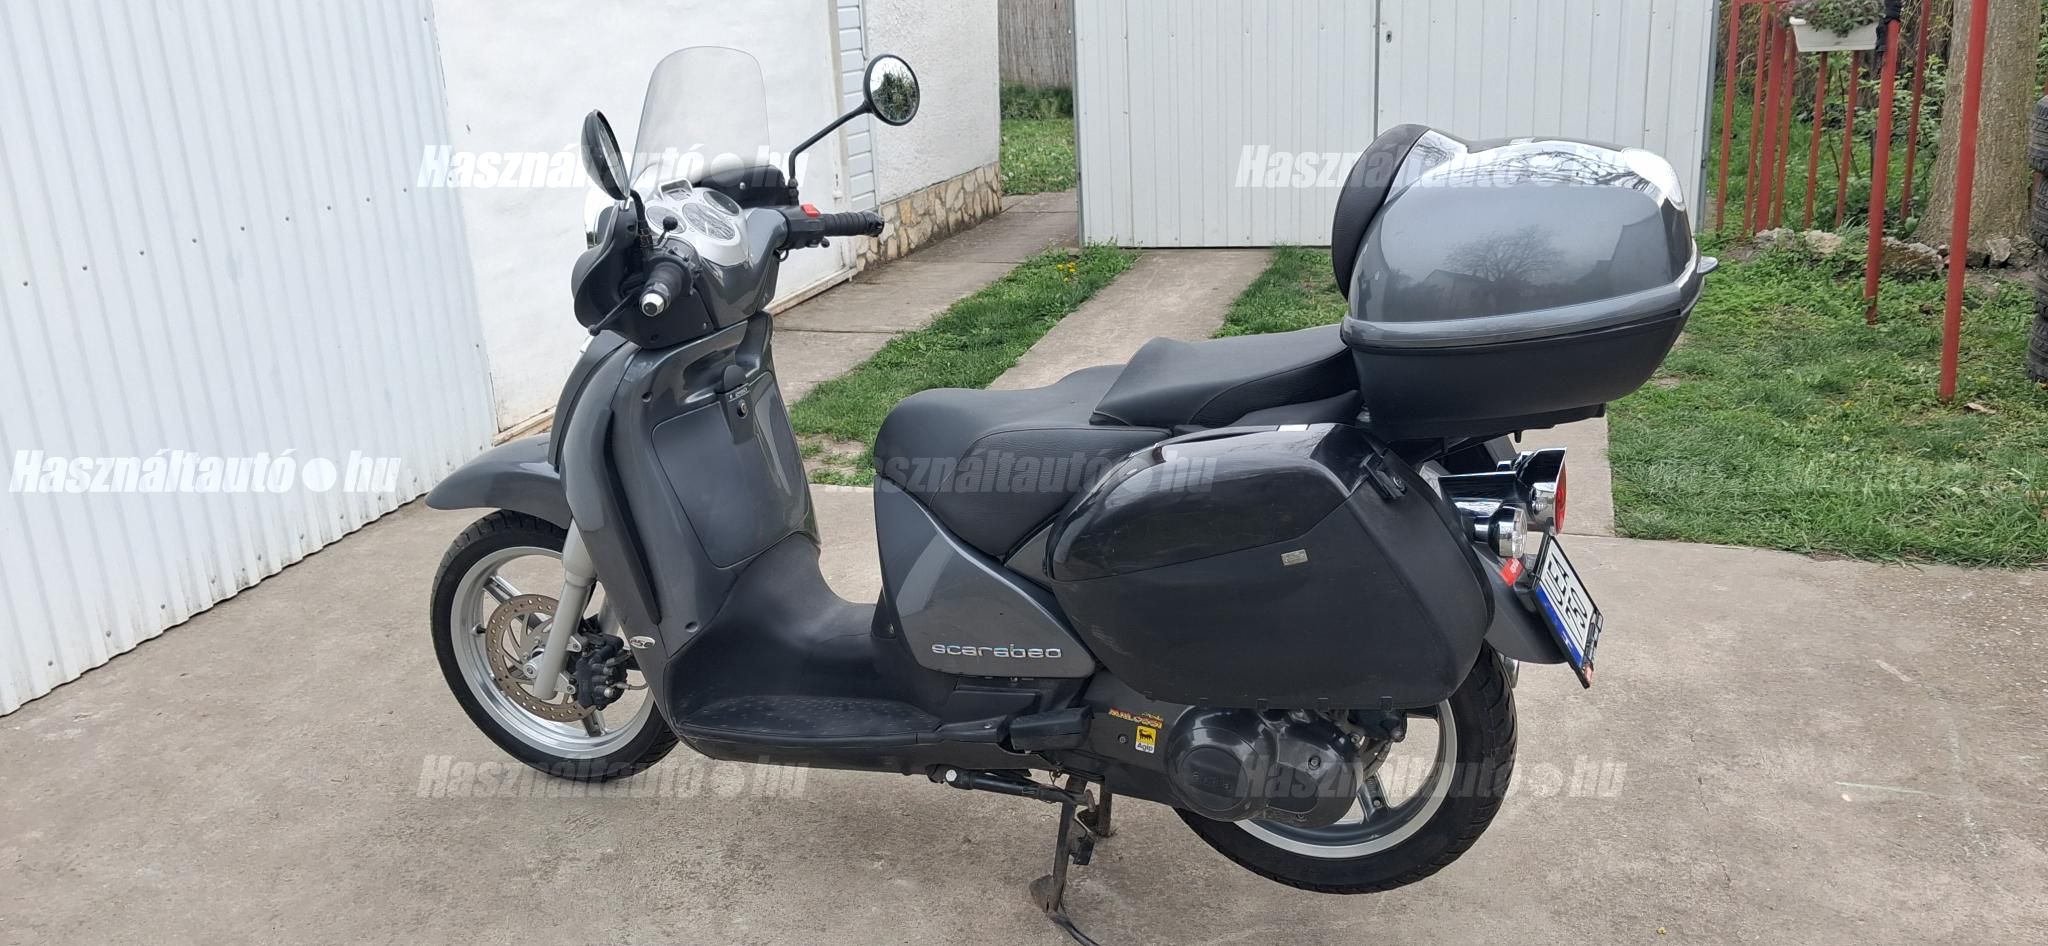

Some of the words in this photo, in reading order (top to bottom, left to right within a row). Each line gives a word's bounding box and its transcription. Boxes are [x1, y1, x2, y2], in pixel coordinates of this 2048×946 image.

[1566, 587, 1588, 641] 750
[931, 643, 1062, 658] scarabeo
[1137, 743, 1153, 752] Agip
